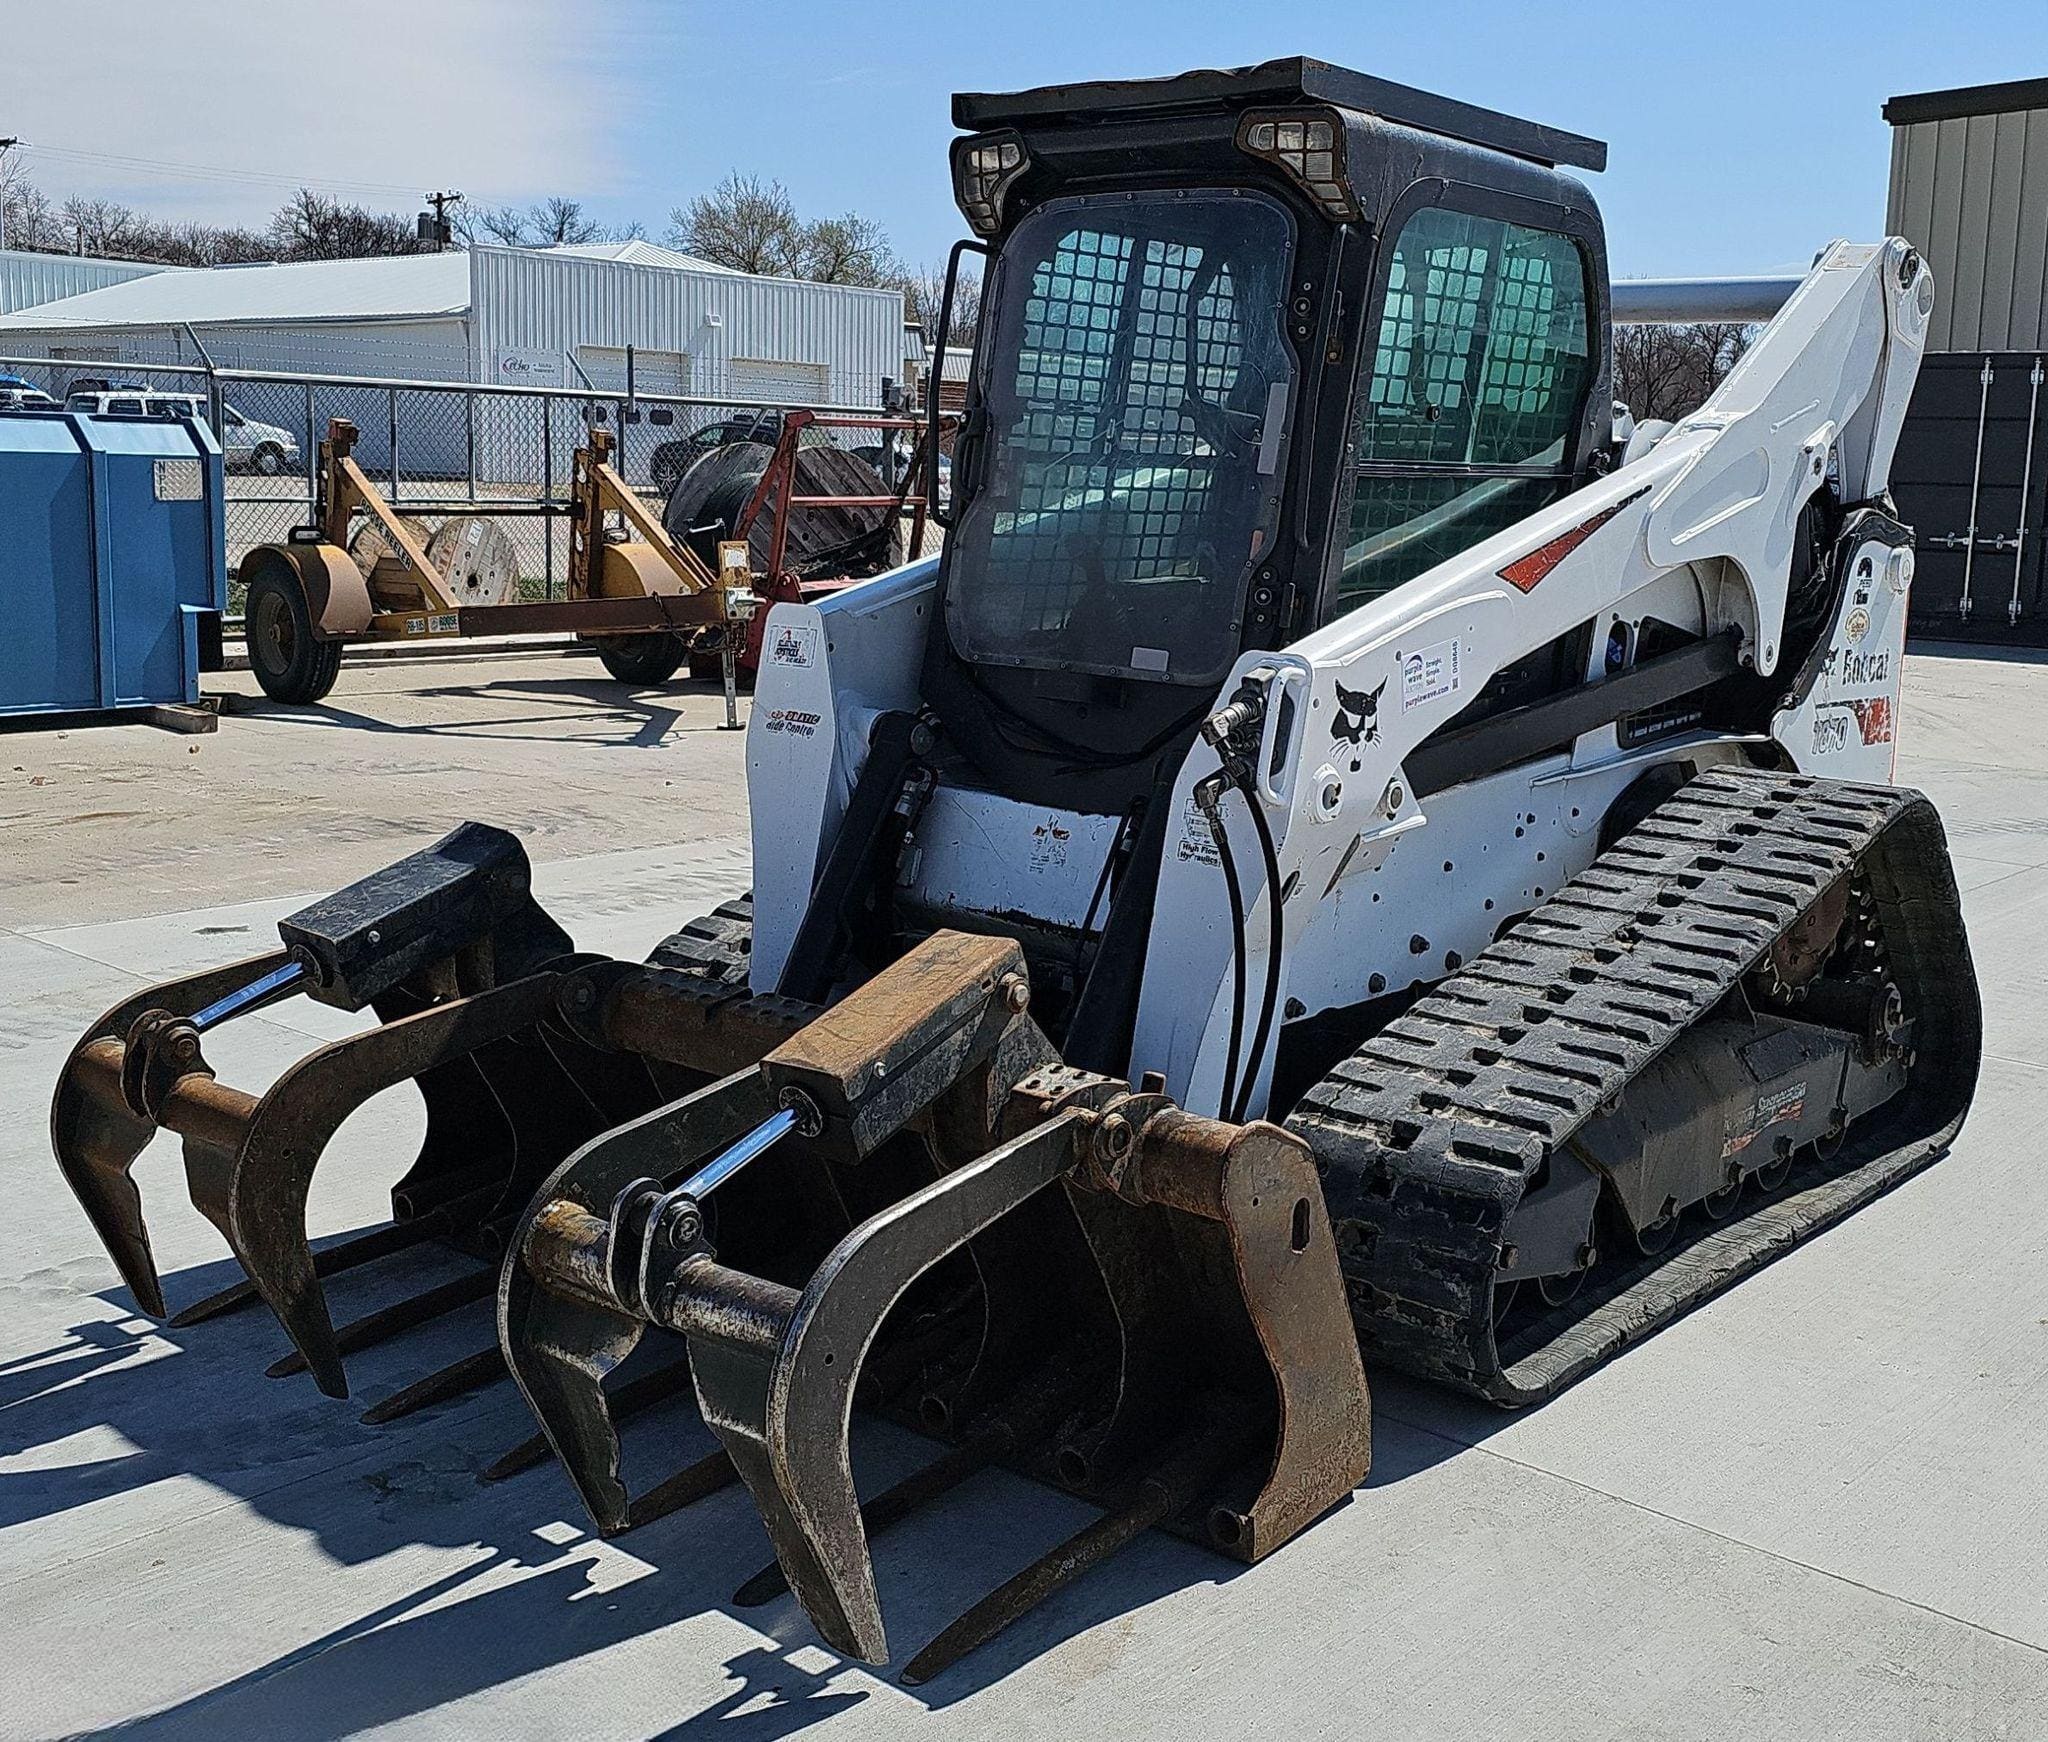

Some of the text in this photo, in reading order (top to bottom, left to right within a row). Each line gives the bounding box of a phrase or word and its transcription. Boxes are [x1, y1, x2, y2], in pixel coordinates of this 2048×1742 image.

[384, 528, 412, 569] REELER
[1405, 663, 1422, 678] purple
[1408, 674, 1422, 684] wave
[1405, 686, 1448, 708] purplewave.com
[1182, 843, 1218, 855] High Flow
[1180, 851, 1218, 864] Hyraulics
